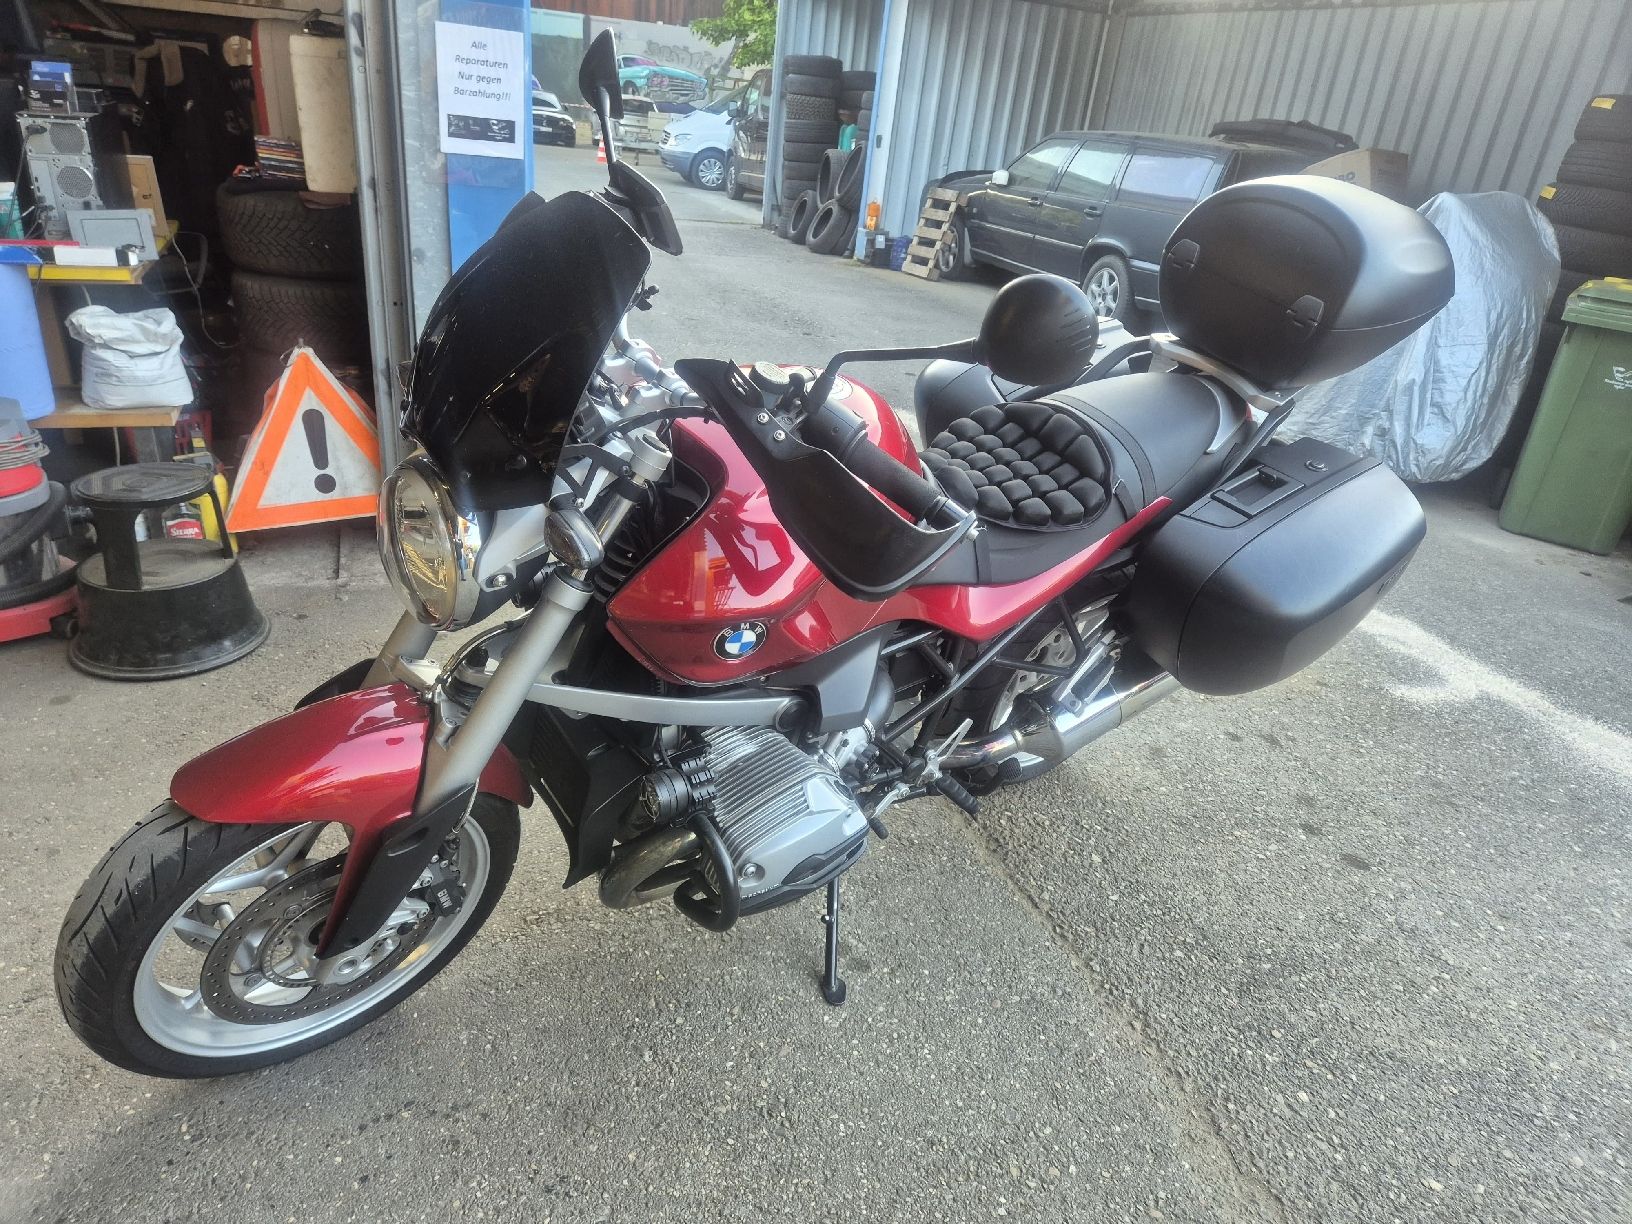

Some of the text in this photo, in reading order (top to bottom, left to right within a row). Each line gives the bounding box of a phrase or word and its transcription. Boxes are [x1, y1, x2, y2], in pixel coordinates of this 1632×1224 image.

[471, 41, 488, 51] Alle
[454, 54, 509, 70] Reparaturen
[457, 71, 502, 84] Nur gegen
[453, 86, 511, 102] Barzahlung!!!
[723, 622, 764, 637] BMW
[437, 888, 453, 909] BMW
